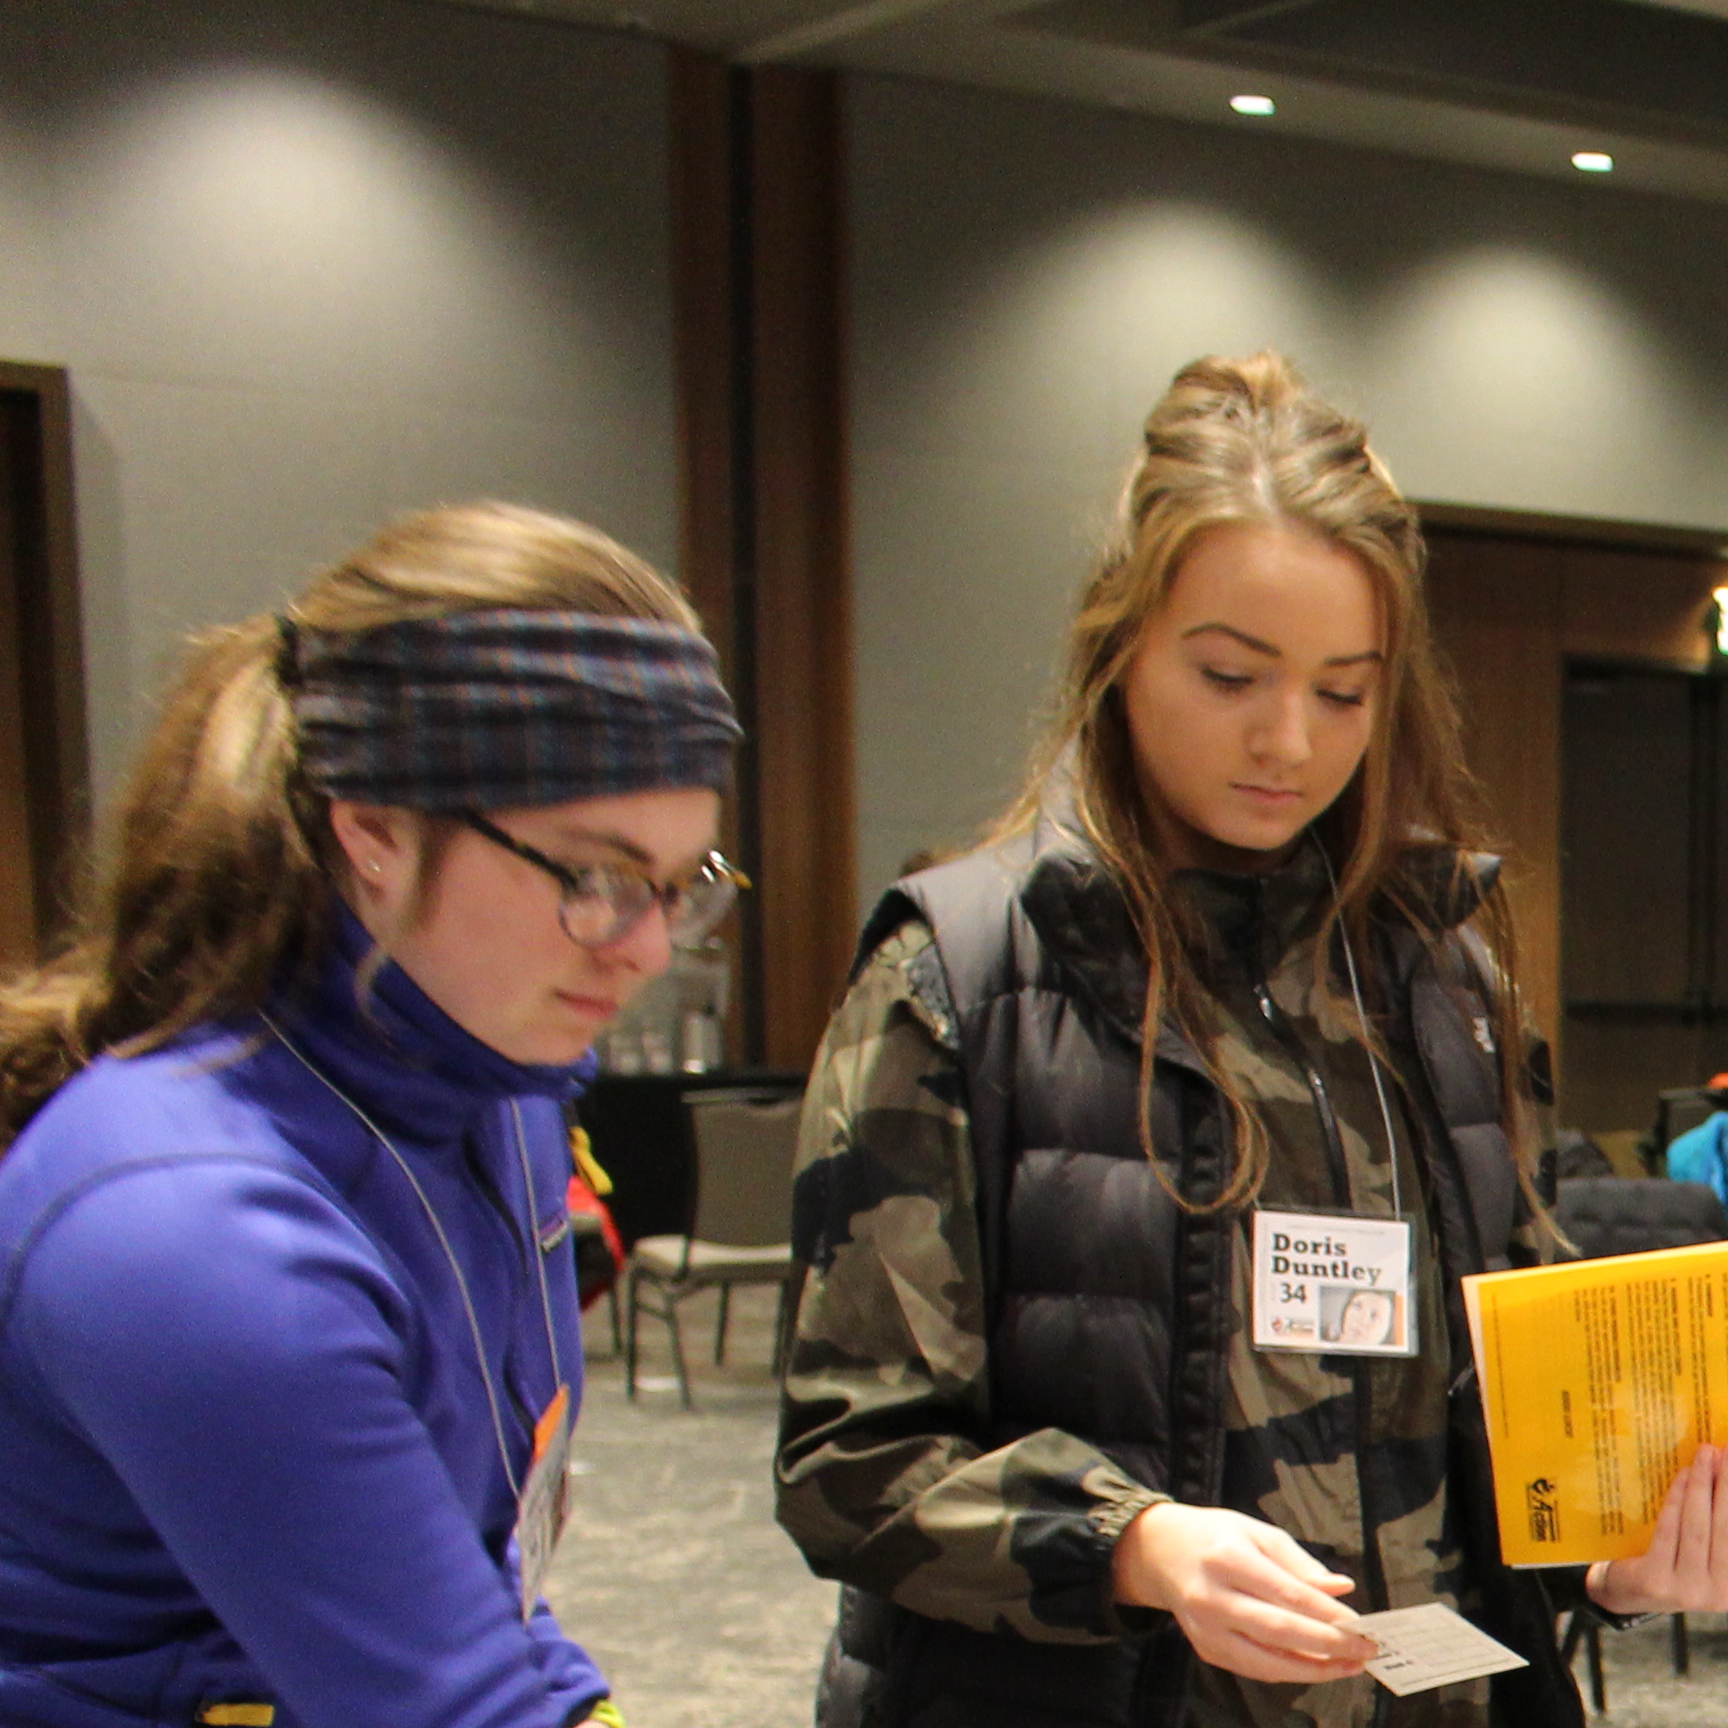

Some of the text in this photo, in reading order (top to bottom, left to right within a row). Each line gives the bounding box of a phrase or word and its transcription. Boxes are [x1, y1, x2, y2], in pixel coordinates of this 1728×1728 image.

[1272, 1233, 1347, 1256] Doris
[1271, 1255, 1382, 1287] Duntley
[1279, 1281, 1308, 1304] 34
